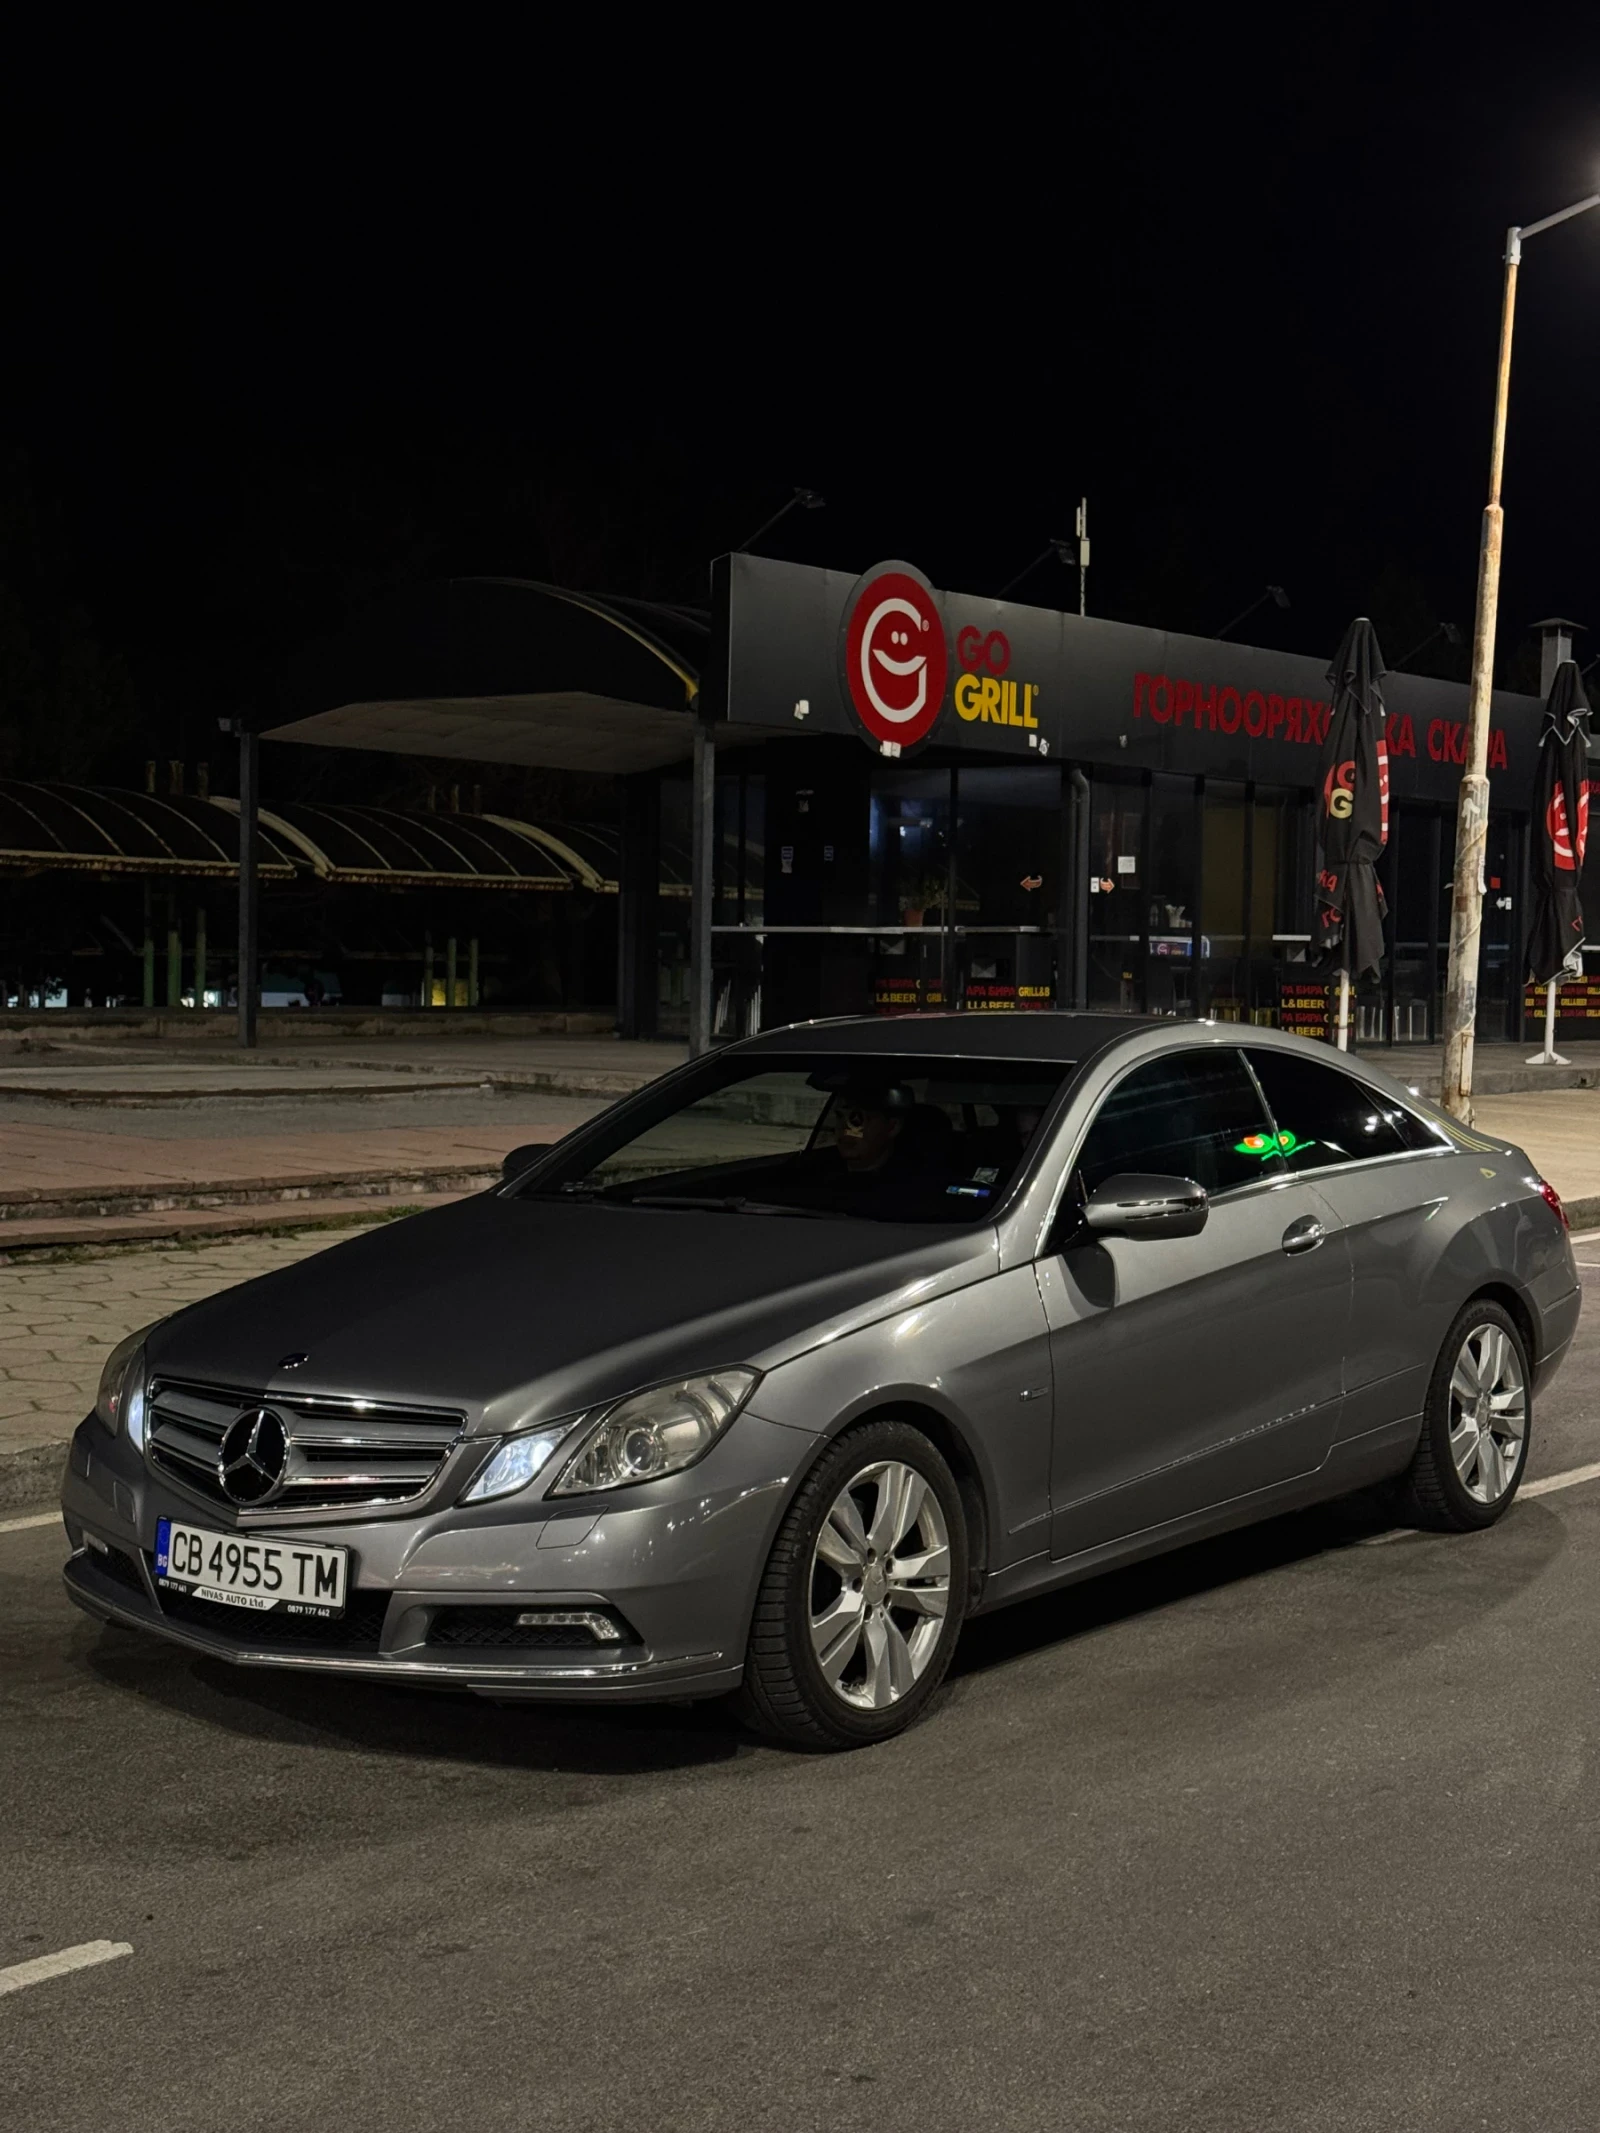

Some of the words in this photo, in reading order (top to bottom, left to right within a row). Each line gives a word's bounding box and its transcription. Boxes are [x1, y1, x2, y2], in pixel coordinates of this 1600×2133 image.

[956, 624, 1011, 676] GO
[1133, 671, 1417, 758] ГОРНООРЯХКА
[1426, 717, 1508, 771] СКА
[157, 1553, 168, 1568] BG
[172, 1531, 203, 1577] CB
[208, 1540, 283, 1591] 4955
[292, 1552, 338, 1600] TM
[201, 1588, 224, 1602] NIVAS
[225, 1594, 247, 1606] AUTO
[249, 1598, 267, 1609] Ltd.
[304, 1606, 317, 1616] 177
